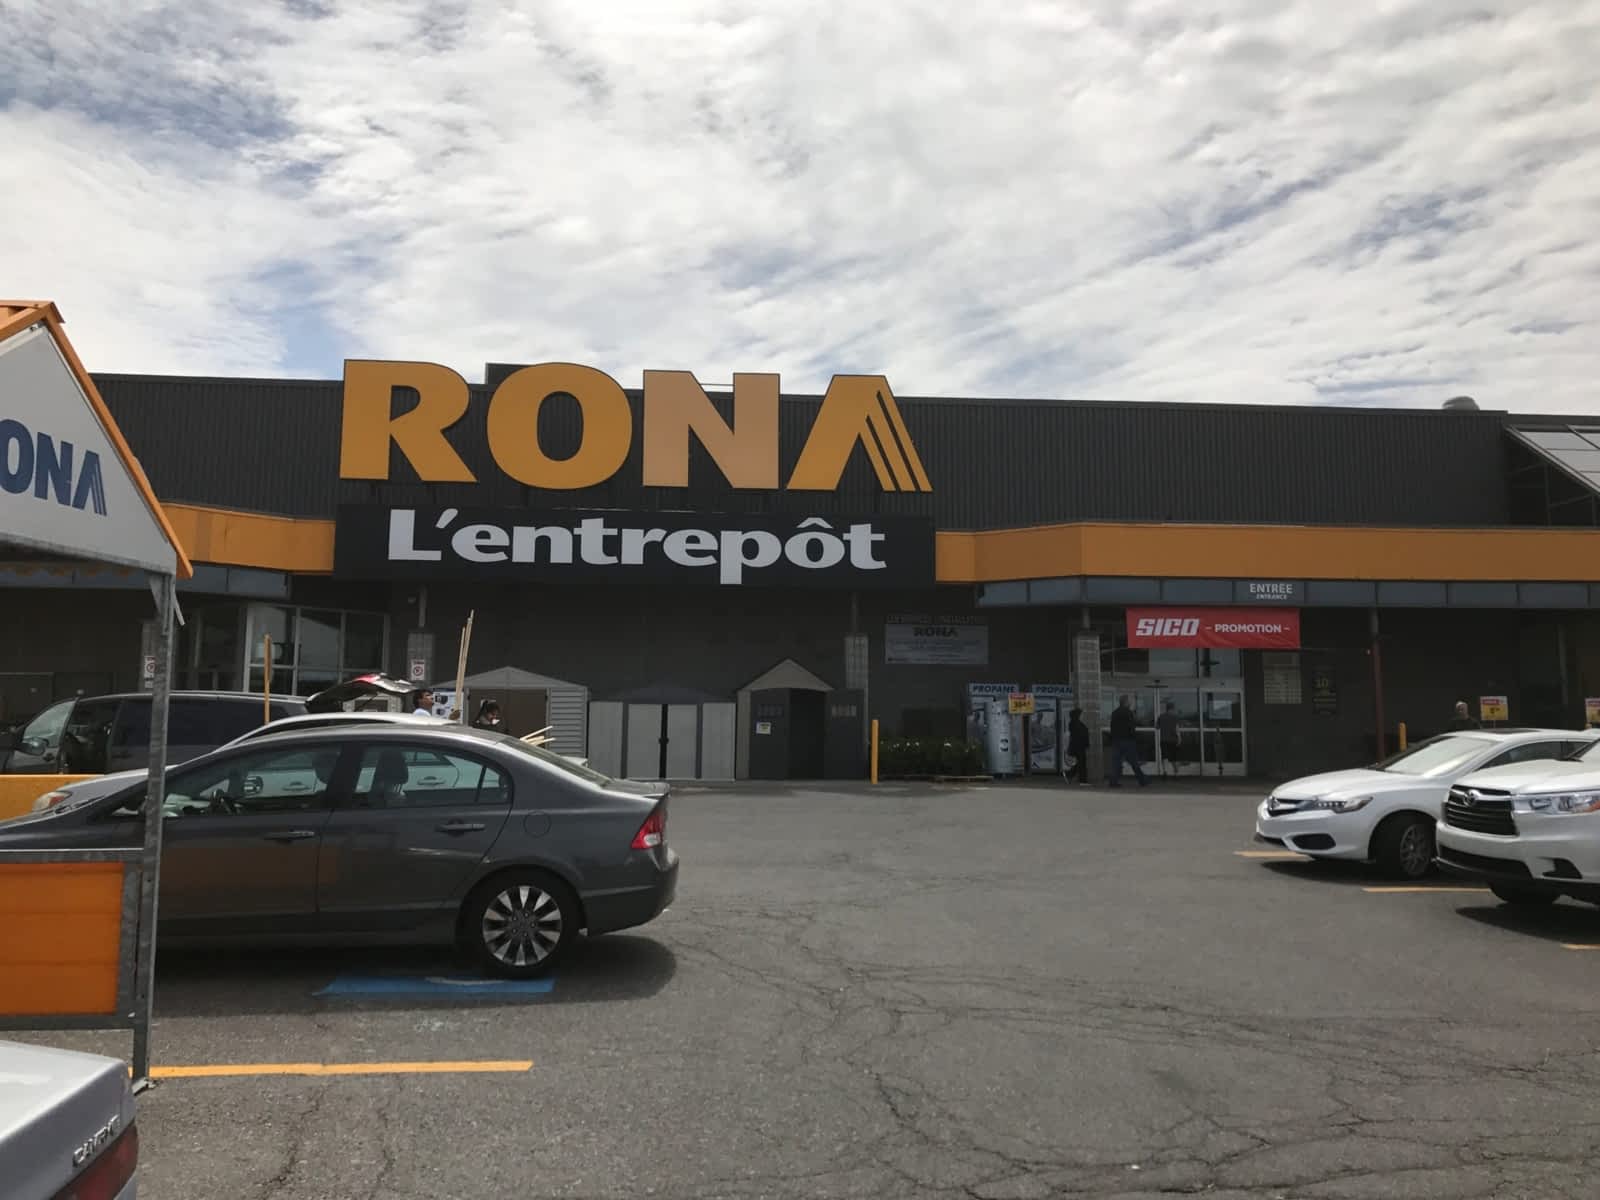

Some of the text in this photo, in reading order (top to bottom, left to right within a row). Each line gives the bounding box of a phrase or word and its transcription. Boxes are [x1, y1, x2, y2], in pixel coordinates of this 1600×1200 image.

[339, 359, 934, 492] RONA
[387, 508, 887, 585] L'entrepôt
[1136, 618, 1282, 637] SICO PROMOTION
[973, 685, 1016, 694] PROPANE
